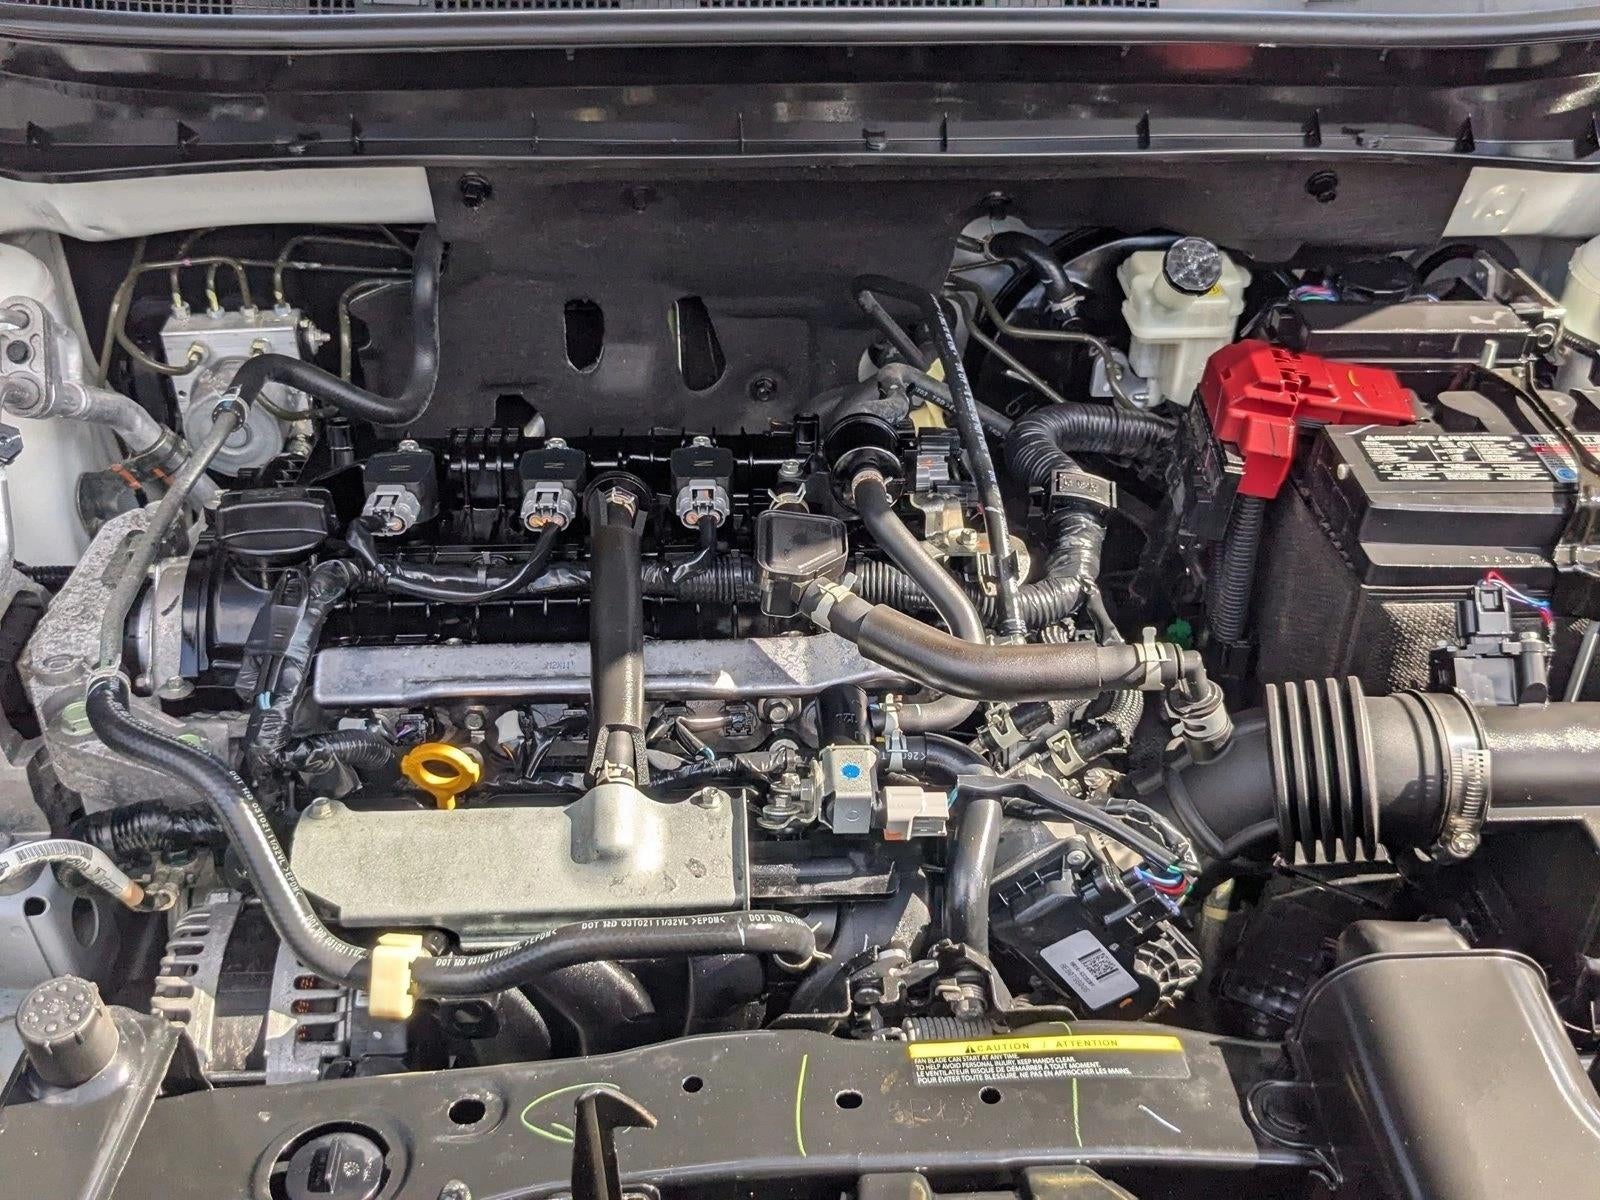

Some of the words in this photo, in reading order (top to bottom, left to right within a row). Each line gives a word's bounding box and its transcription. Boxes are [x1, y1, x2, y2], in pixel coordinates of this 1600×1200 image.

[748, 914, 766, 922] DOT
[581, 921, 598, 930] DOT
[436, 958, 452, 967] DOT
[977, 1042, 1030, 1052] CAUTION
[1056, 1039, 1118, 1048] ATTENTION
[962, 1060, 994, 1068] PERSONAL
[925, 1069, 970, 1077] VENTILATEUR
[1069, 1061, 1101, 1069] MOMENT.
[961, 1074, 983, 1082] TOUTE
[1054, 1068, 1095, 1077] APPROCHER
